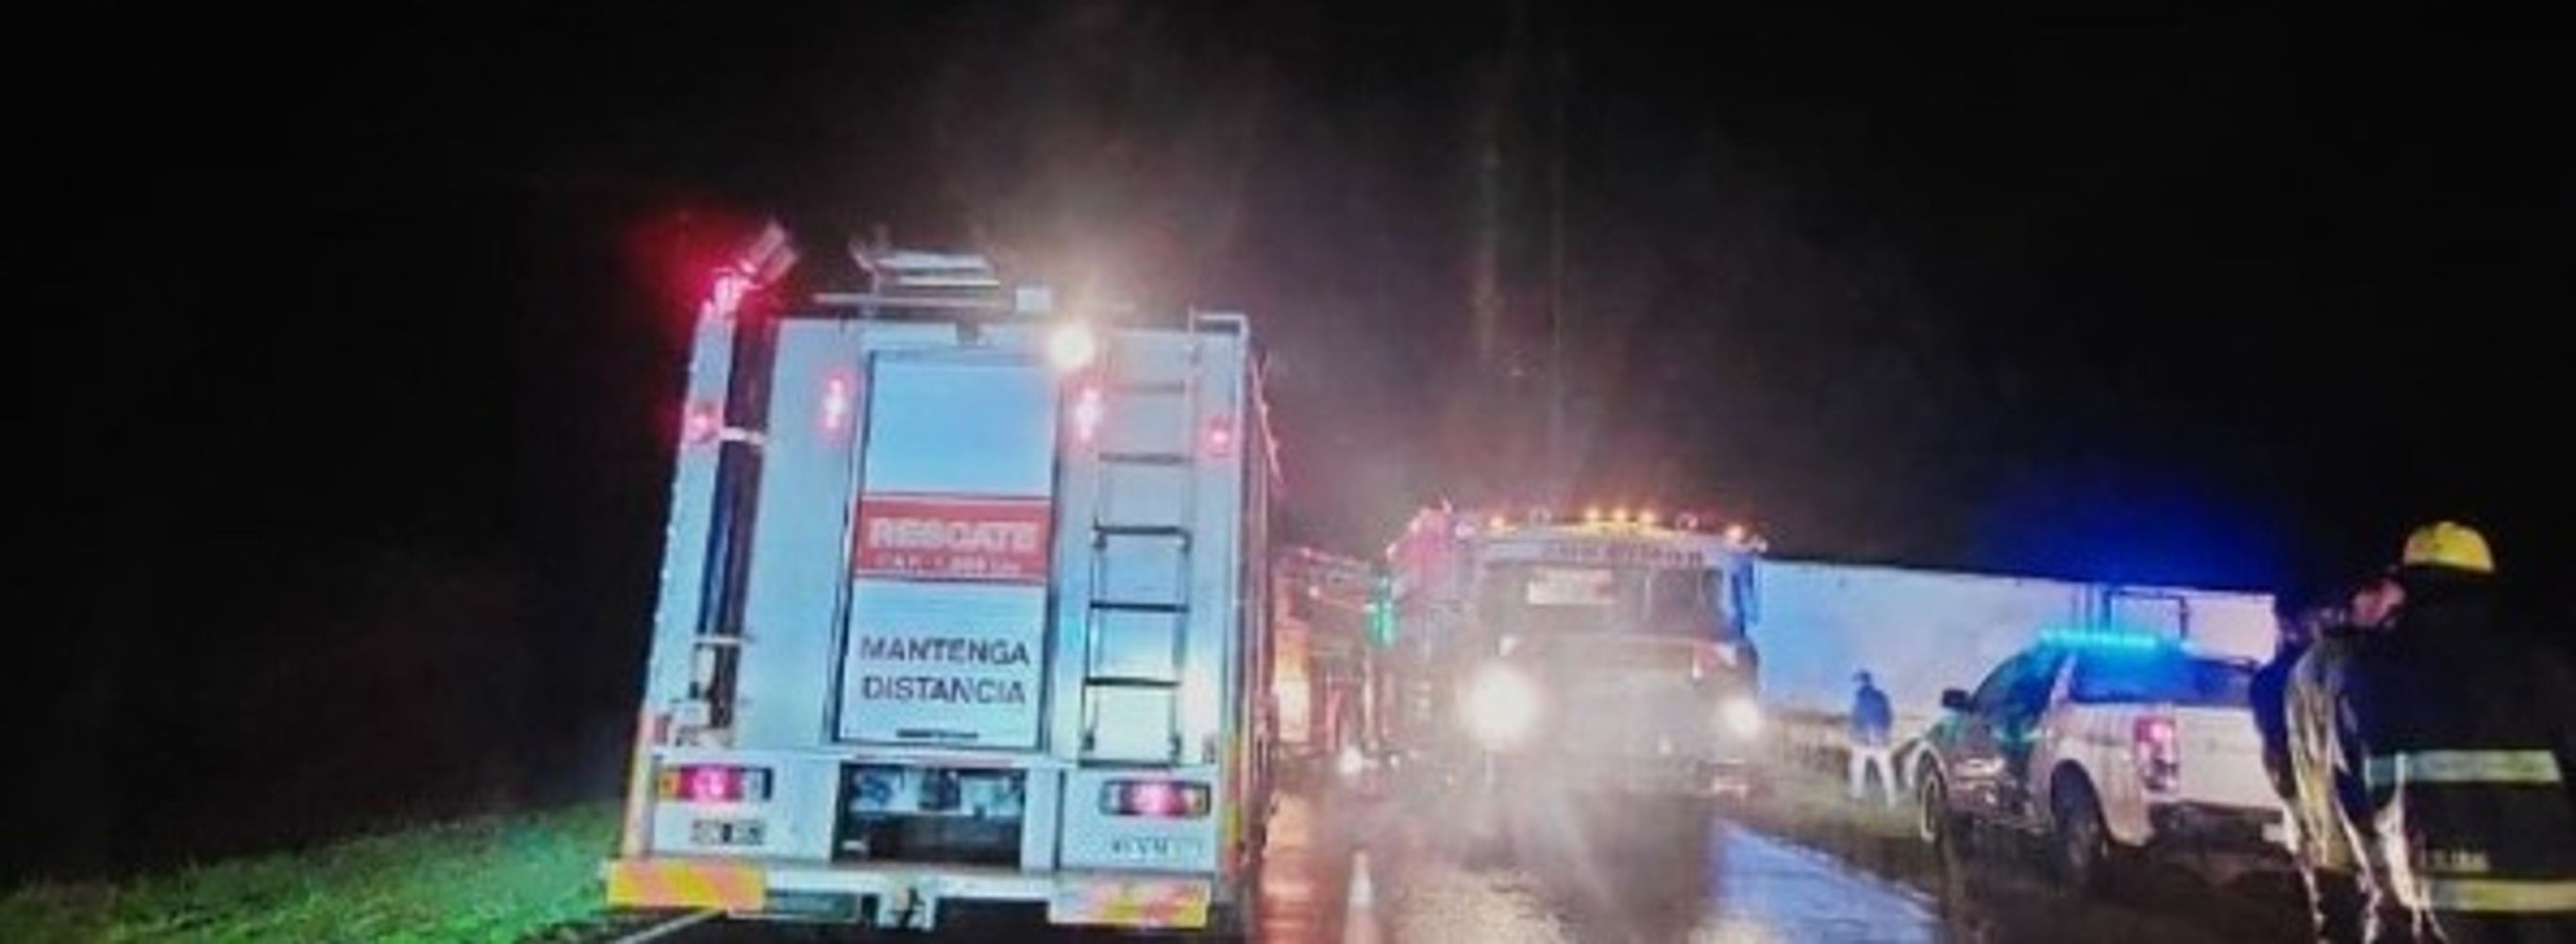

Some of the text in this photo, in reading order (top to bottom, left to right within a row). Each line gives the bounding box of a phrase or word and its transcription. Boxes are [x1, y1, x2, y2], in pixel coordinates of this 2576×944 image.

[869, 517, 1037, 551] RESCATE
[860, 636, 1030, 666] MANTENGA
[862, 674, 1027, 704] DISTANCIA
